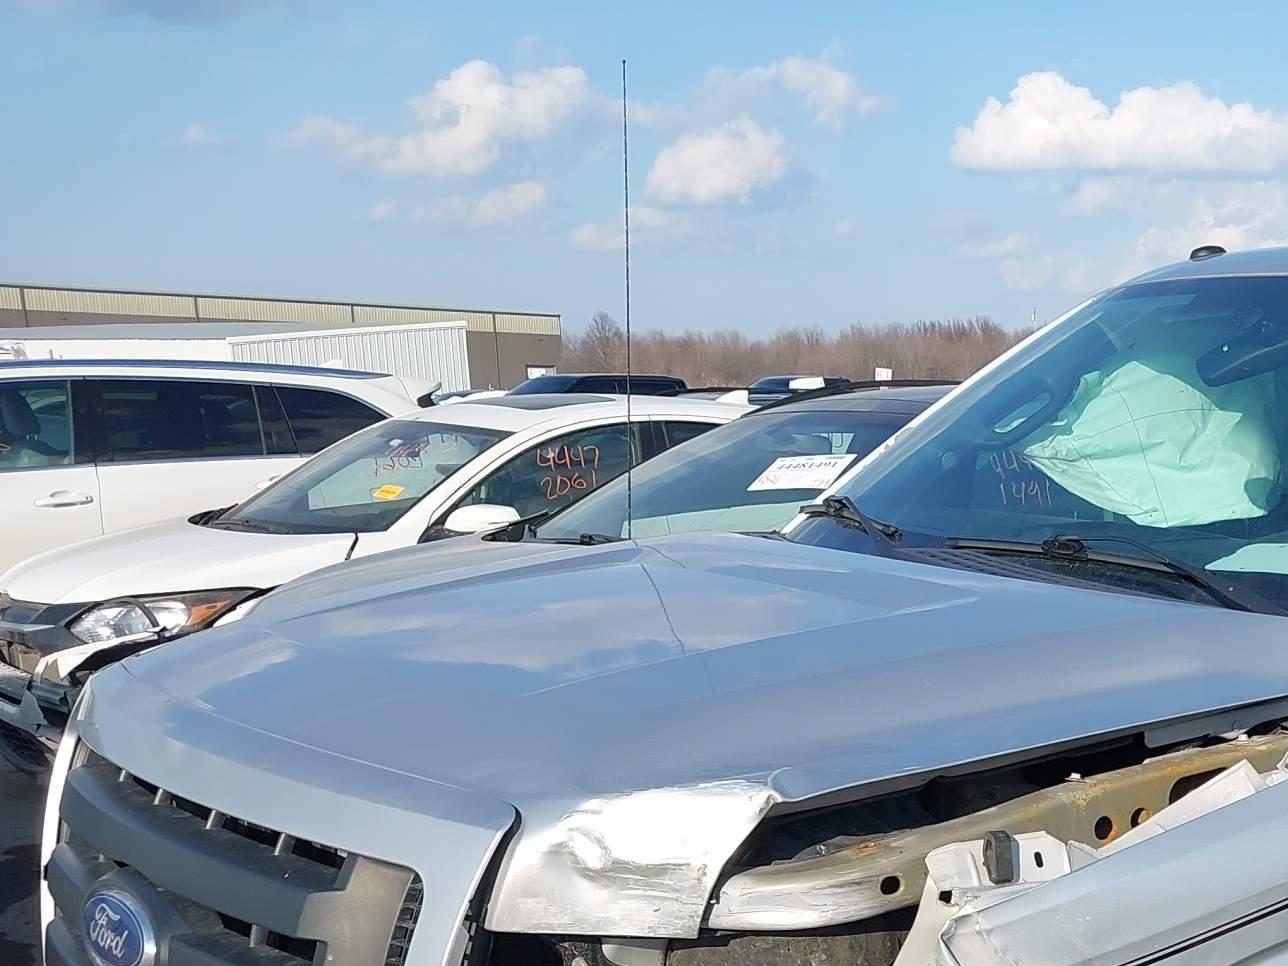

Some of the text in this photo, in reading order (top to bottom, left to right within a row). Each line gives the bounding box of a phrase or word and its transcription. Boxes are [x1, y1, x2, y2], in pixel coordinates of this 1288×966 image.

[537, 445, 599, 471] 4447
[540, 472, 597, 499] 2061
[89, 903, 129, 958] Ford
